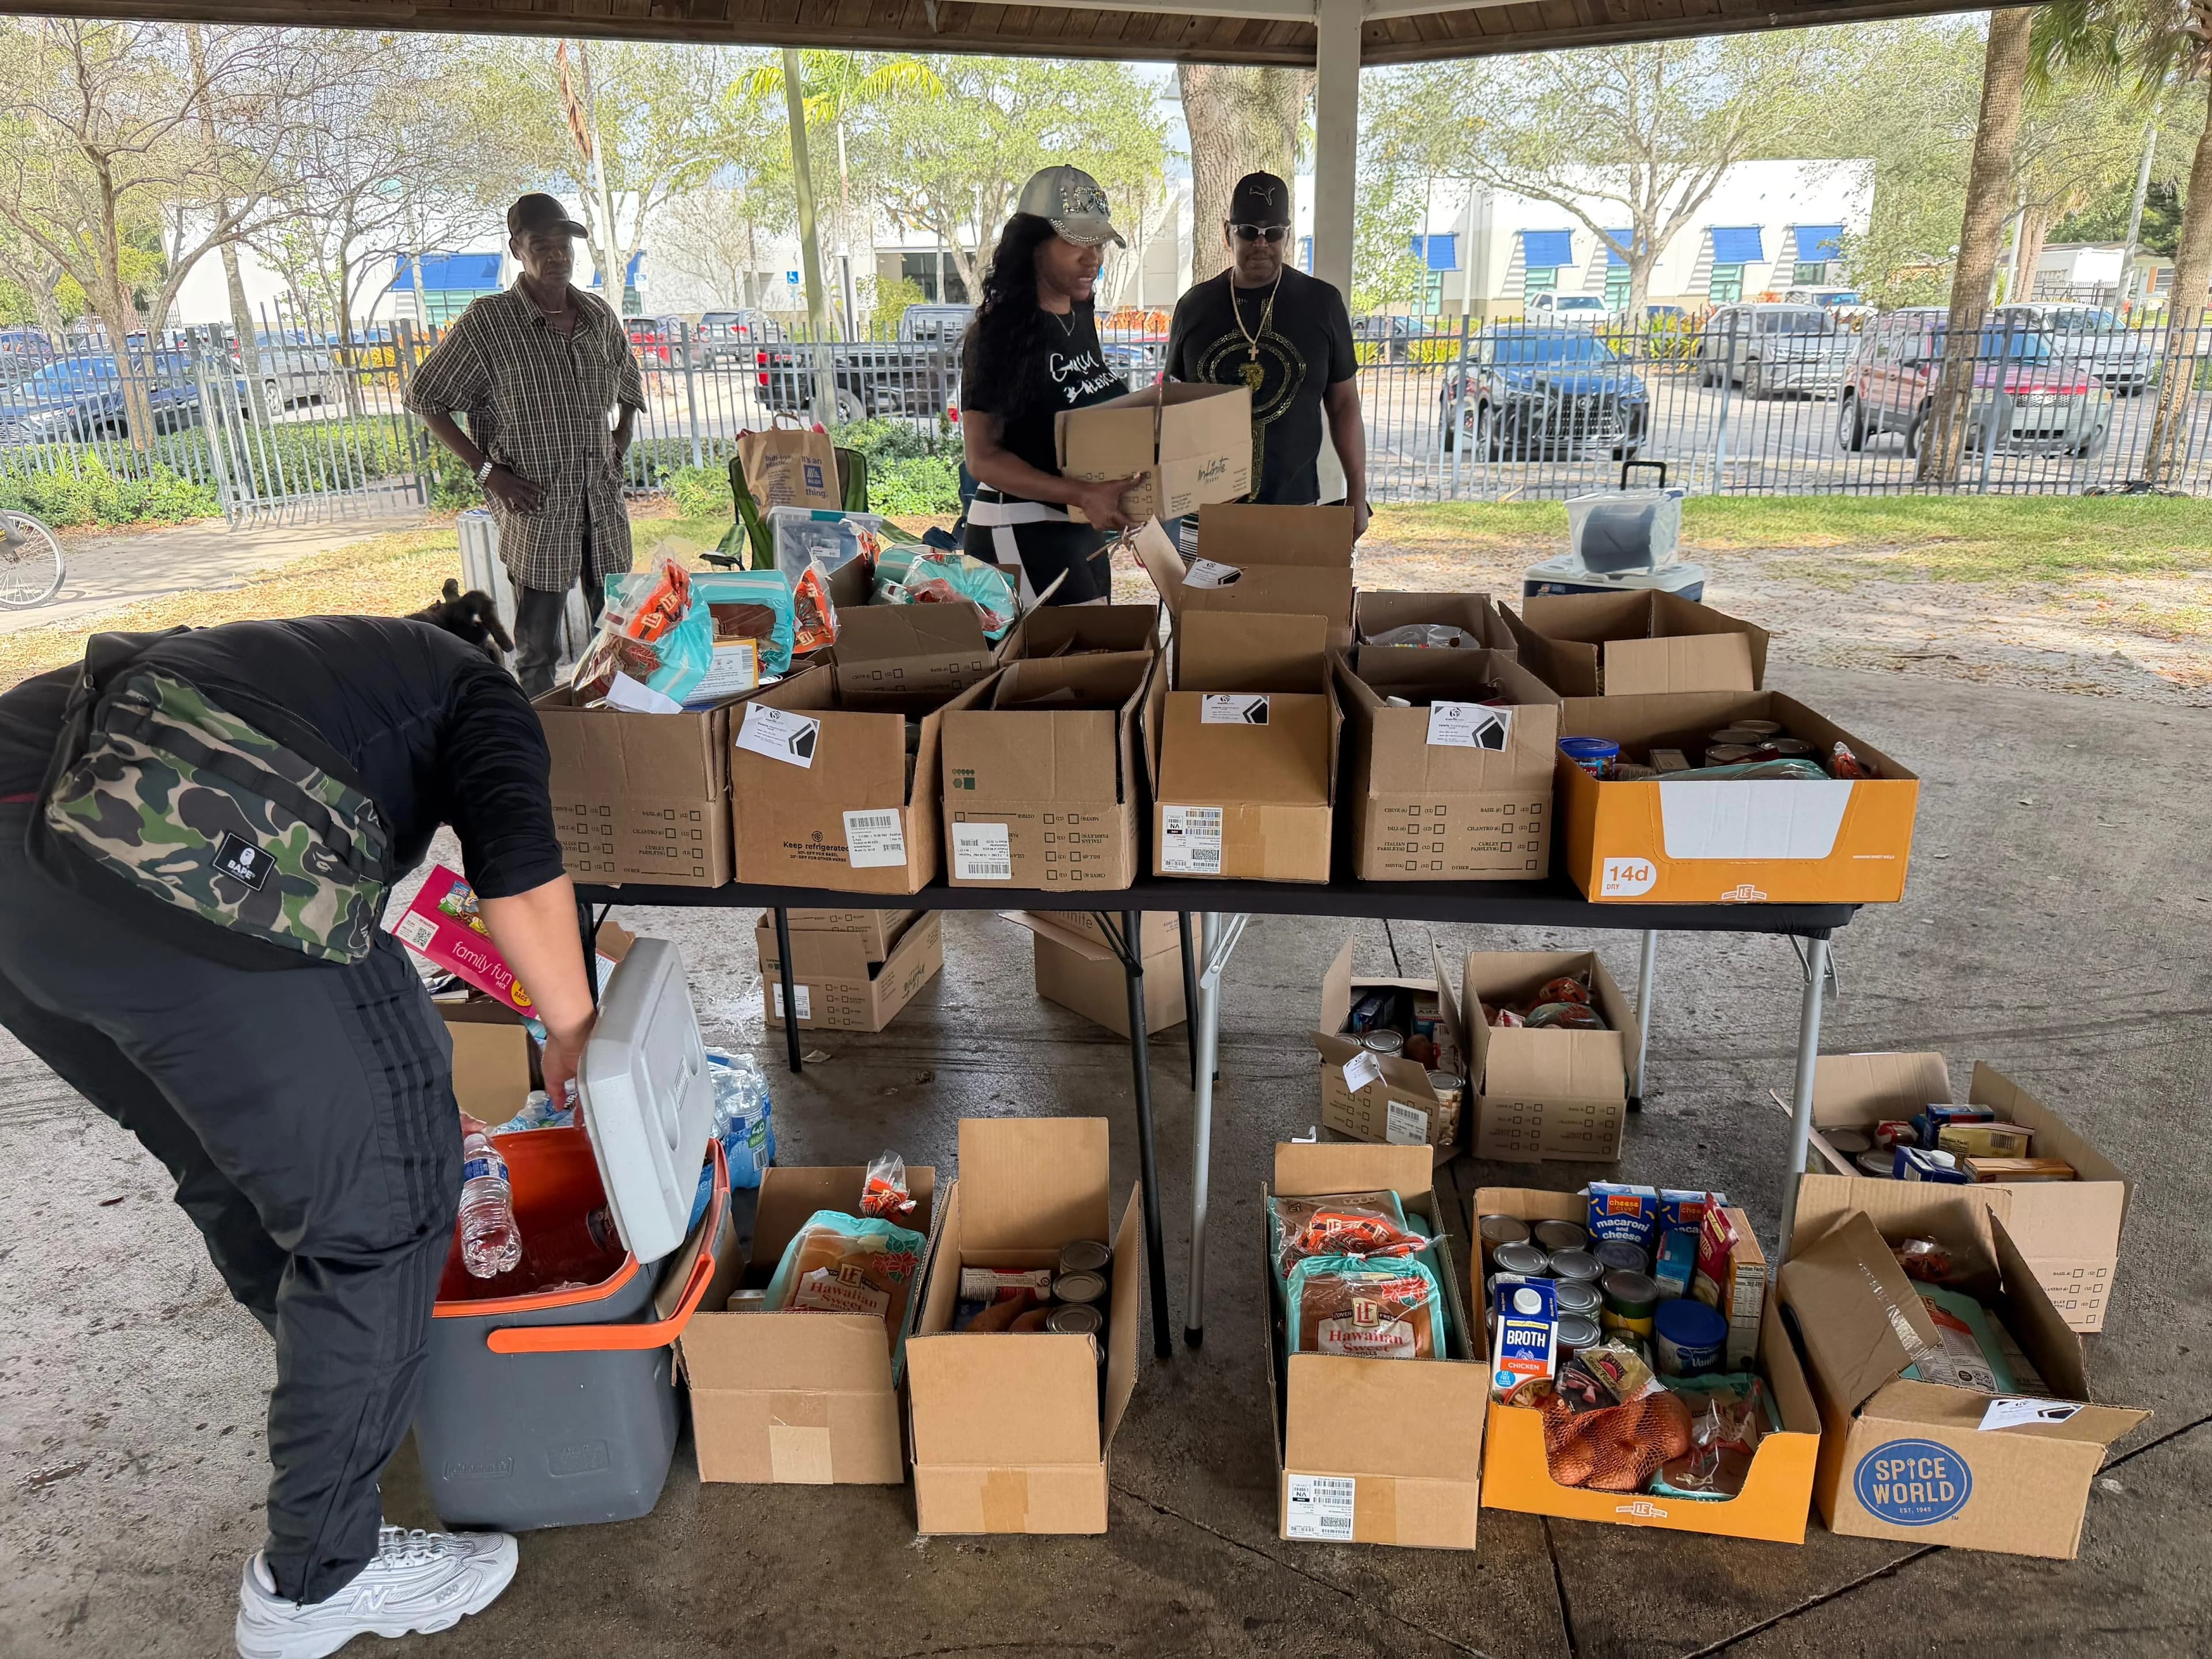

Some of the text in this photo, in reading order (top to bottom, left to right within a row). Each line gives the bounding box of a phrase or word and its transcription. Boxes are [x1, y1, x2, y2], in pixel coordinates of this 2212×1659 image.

[806, 489, 828, 499] thing.
[783, 841, 802, 850] Keep
[228, 859, 251, 880] BAPE
[1609, 865, 1649, 881] 14d
[452, 941, 512, 985] family fun
[496, 980, 508, 990] MIX
[514, 991, 528, 1002] BAGS
[752, 1121, 765, 1135] 40
[1609, 1199, 1639, 1208] cheese
[1597, 1219, 1650, 1232] macaroni
[1602, 1230, 1642, 1242] cheese
[810, 1282, 878, 1308] Hawaiian
[821, 1294, 862, 1311] Sweet
[1357, 1301, 1376, 1323] LF
[1507, 1330, 1547, 1348] BROTH
[1343, 1342, 1389, 1353] Sweet
[1508, 1362, 1540, 1370] CHICKEN
[1875, 1457, 1946, 1481] SPICE
[1873, 1481, 1955, 1505] WORLD
